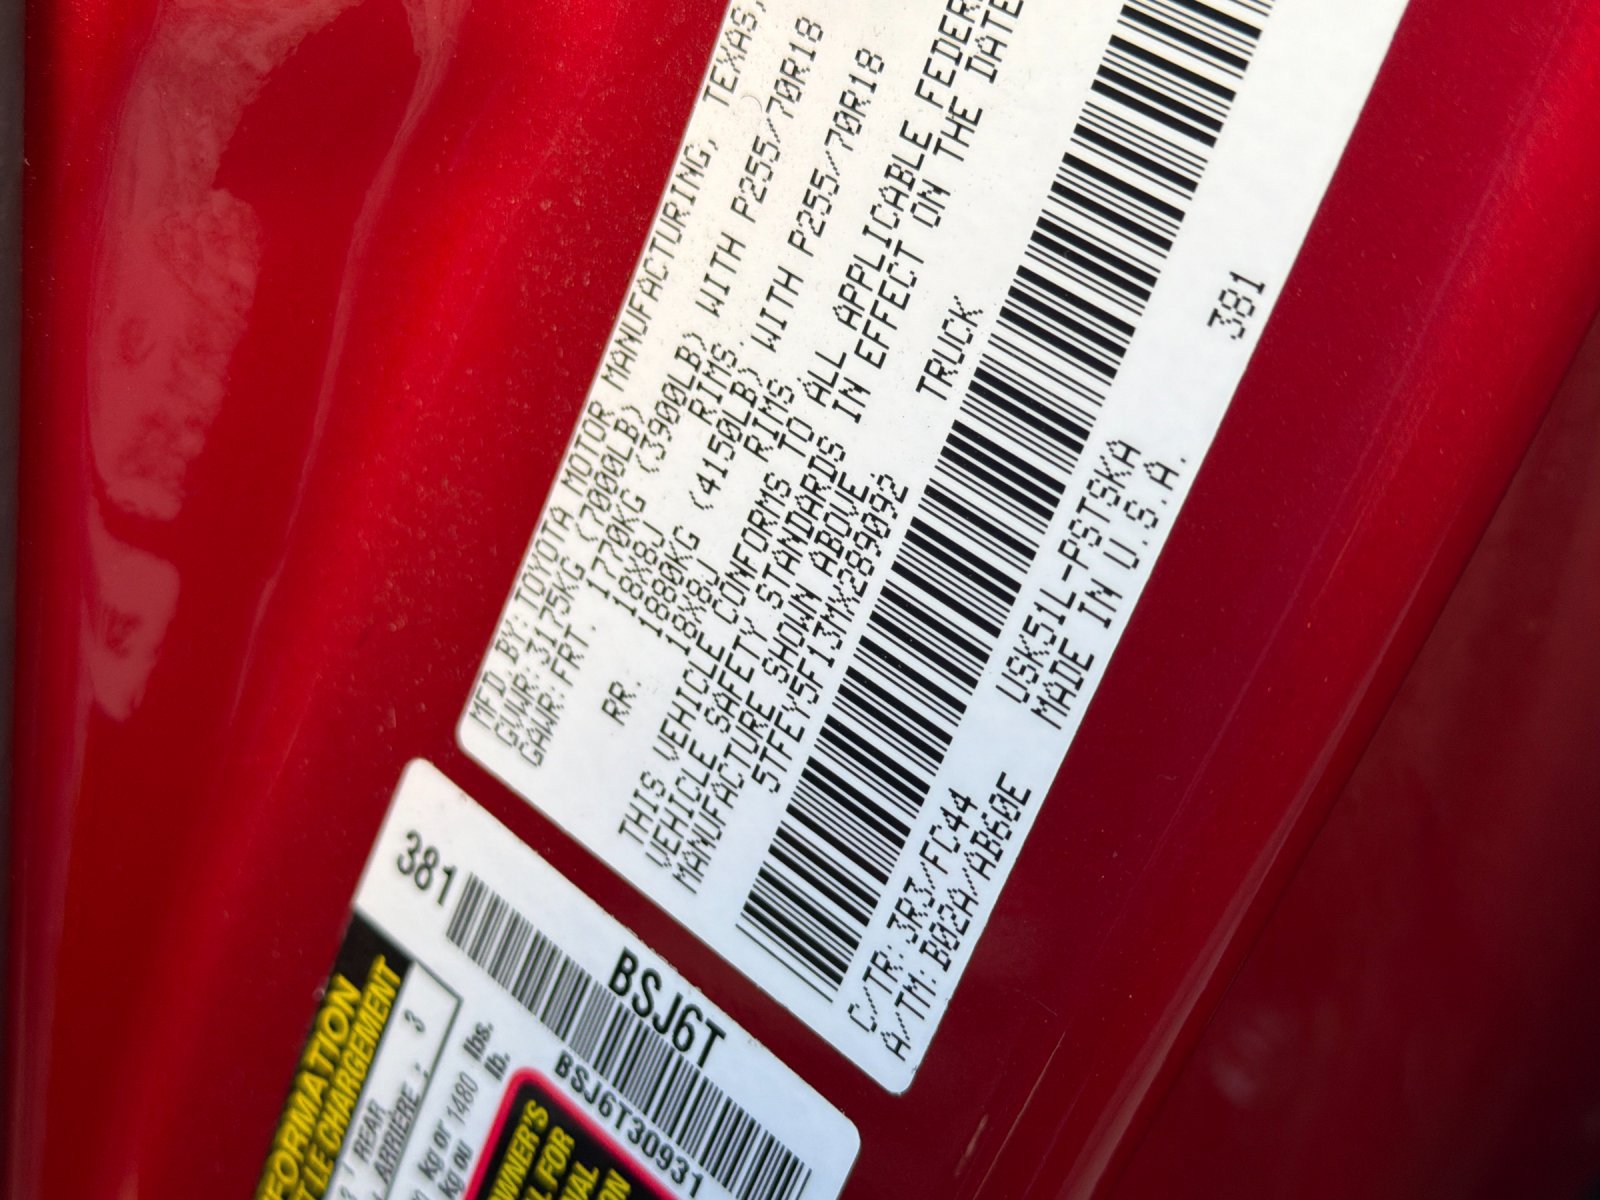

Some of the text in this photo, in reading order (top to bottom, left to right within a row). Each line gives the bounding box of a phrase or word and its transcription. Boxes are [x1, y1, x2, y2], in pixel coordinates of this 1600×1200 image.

[560, 399, 614, 496] MOTOR
[601, 140, 717, 391] MANUFACTURING,
[703, 0, 767, 106] TEXAS,
[585, 487, 647, 599] 1770KG
[635, 332, 705, 471] (3900LB)
[696, 231, 745, 317] WITH
[732, 14, 824, 223] P255/70R18
[574, 406, 643, 538] (7000LB)
[600, 46, 886, 726] RR. 1880KG (4150LB) WITH P255/70R18
[611, 341, 744, 617] 18X8J RIMS.
[618, 0, 982, 846] THIS VEHICLE CONFORMS TO ALL APPLICABLE FEDER
[645, 0, 1024, 868] VEHICLE SAFETY STANDARDS IN EFFECT ON THE DATE
[664, 375, 801, 656] 18X8J RIMS.
[752, 295, 983, 793] 5TFEY5F13MX289092 TRUCK
[995, 270, 1266, 706] USK51L-PSTSKA 381
[672, 470, 875, 894] MANUFACTURE SHOWN ABOVE.
[1030, 455, 1187, 730] MADE IN U.S.A.
[394, 828, 457, 907] 381
[262, 973, 363, 1198] FORMATION
[317, 954, 399, 1149] CHARGEMENT
[350, 1009, 427, 1163] REAR 3
[447, 1070, 479, 1124] 1480
[462, 1020, 494, 1061] lbs.
[607, 946, 728, 1068] BSJ6T
[305, 1143, 333, 1189] LE
[417, 1147, 444, 1180] kg
[431, 1119, 451, 1148] or
[451, 1139, 473, 1170] ou
[484, 1052, 510, 1080] lb.
[534, 1125, 575, 1188] FOR
[553, 1050, 704, 1198] BSJ6T30931
